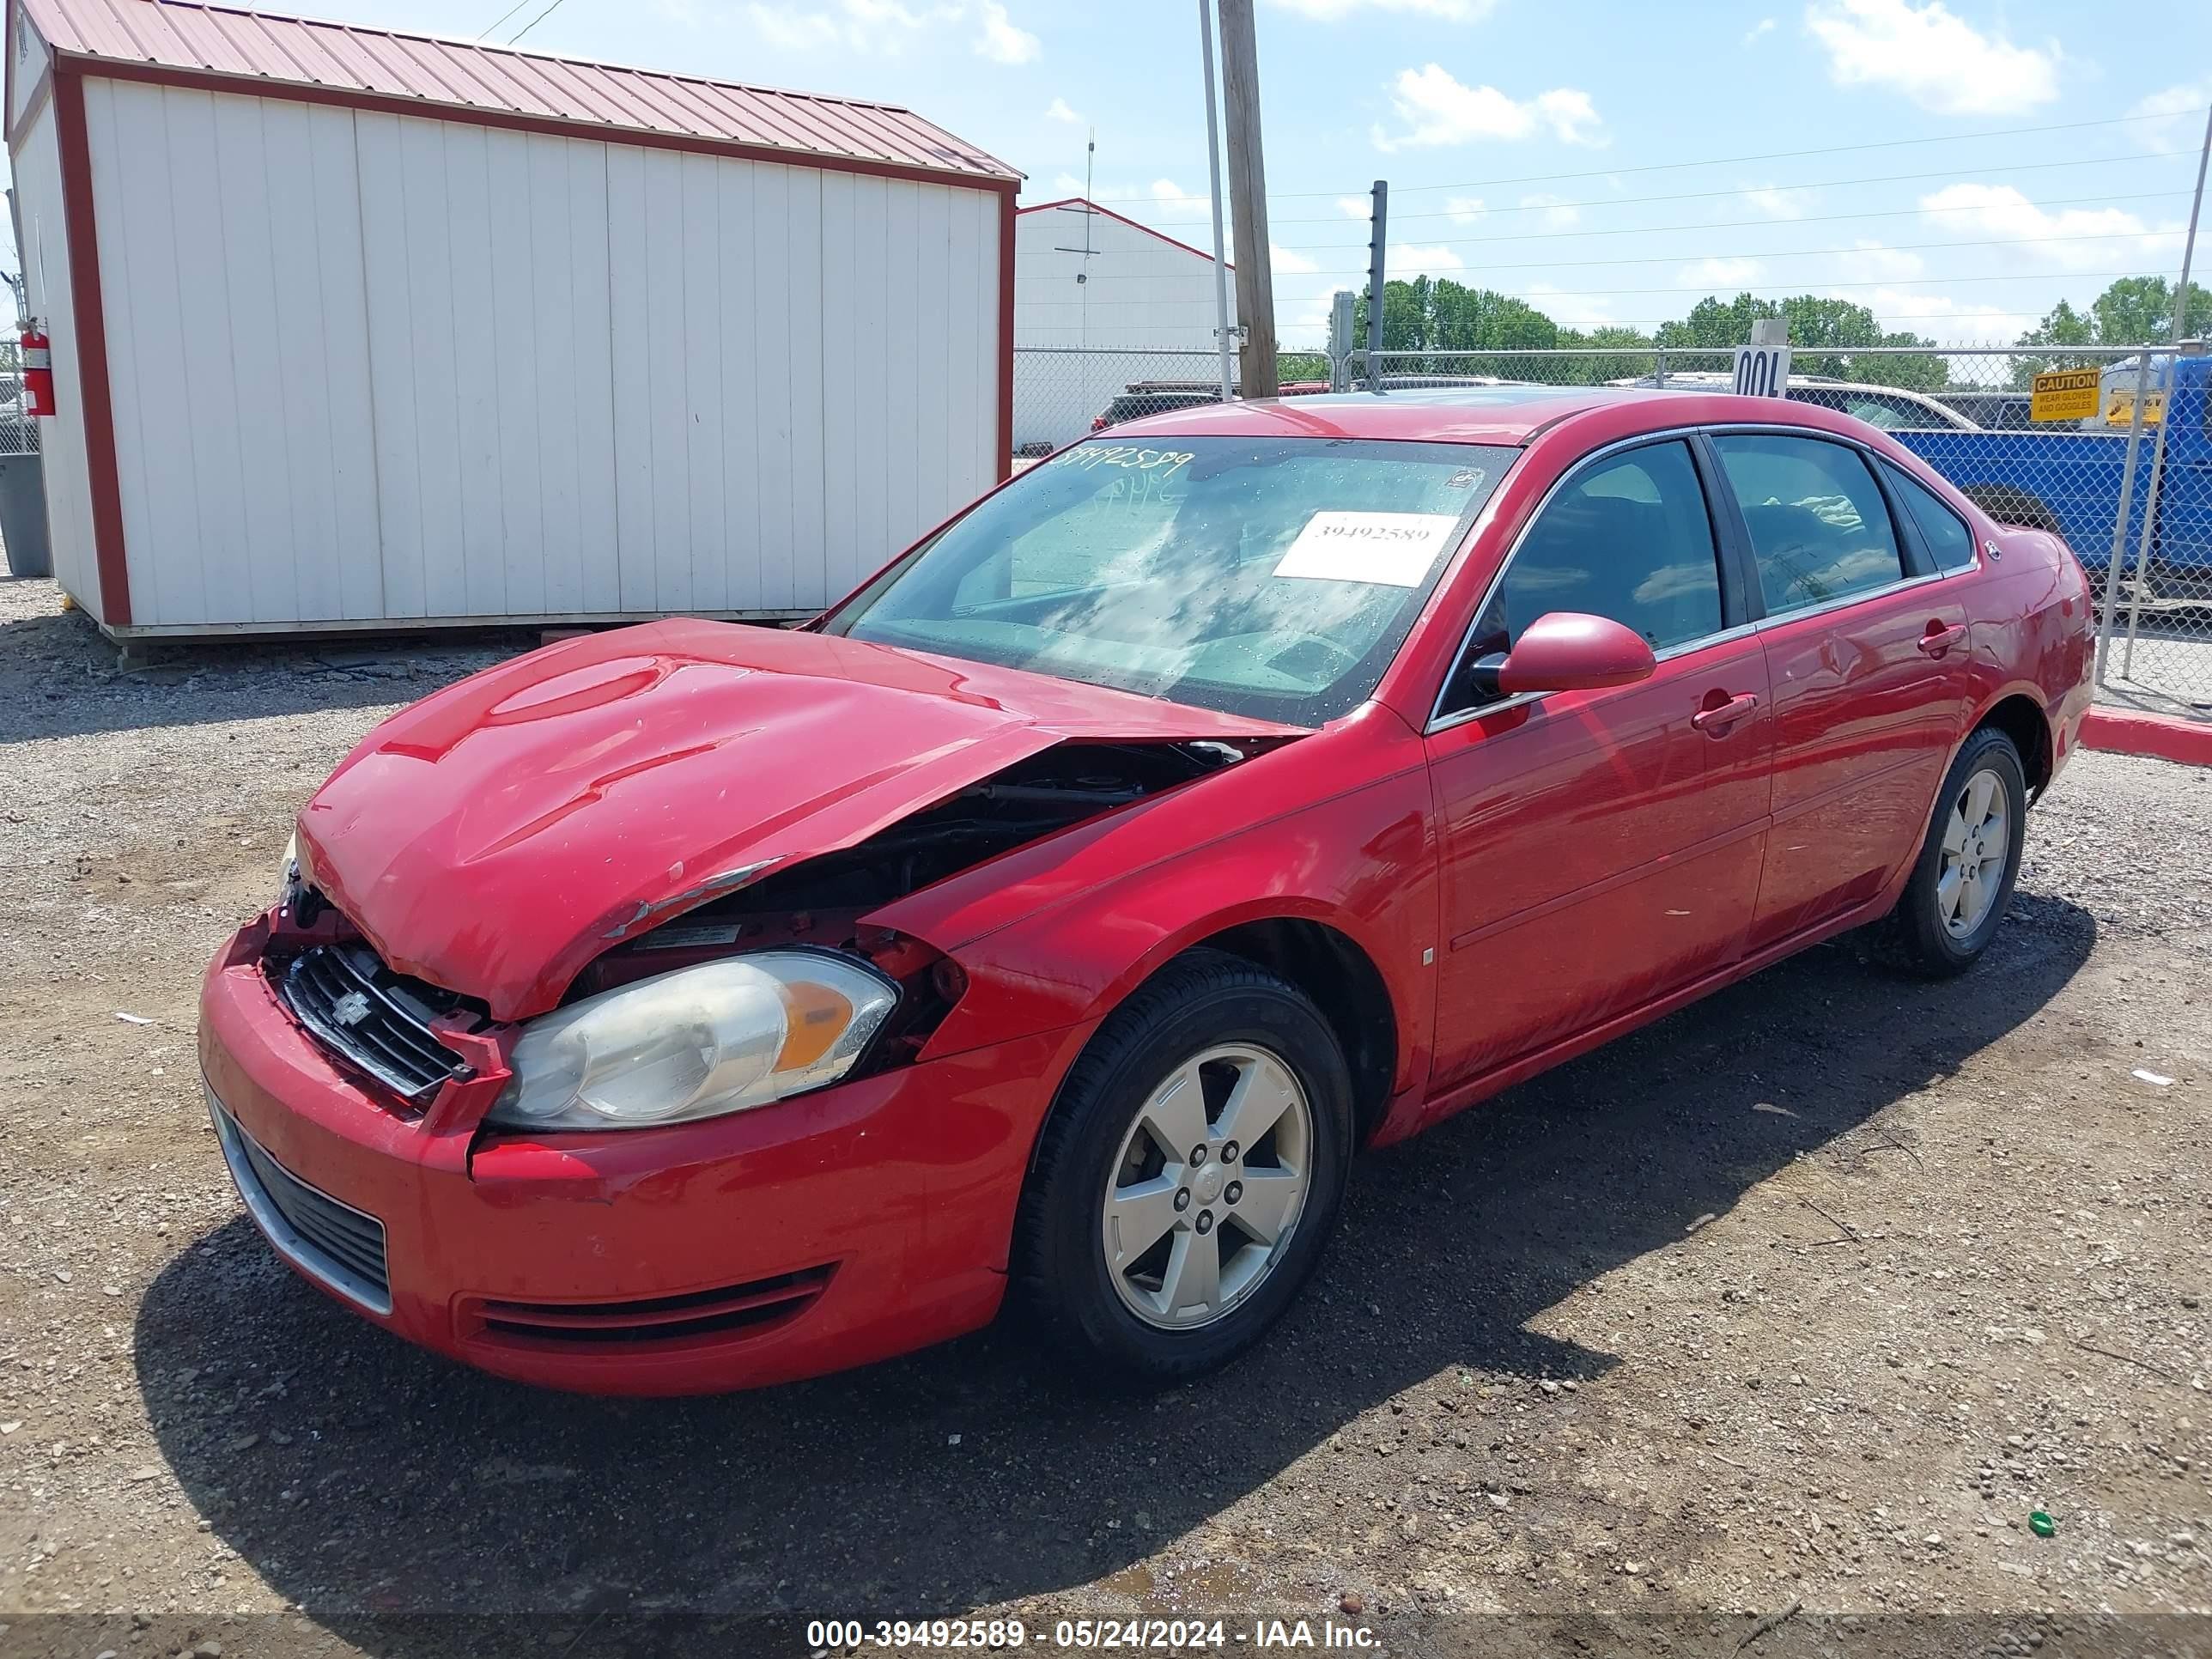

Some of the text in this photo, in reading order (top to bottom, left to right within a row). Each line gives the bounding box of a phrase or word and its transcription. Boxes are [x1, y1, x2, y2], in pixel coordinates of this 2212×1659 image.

[2037, 374, 2096, 392] CAUTION
[2040, 391, 2092, 403] WEAR GLOVES
[2039, 400, 2092, 412] AND GOGGLES
[1049, 446, 1195, 478] 39492589
[1315, 525, 1431, 542] 39492589
